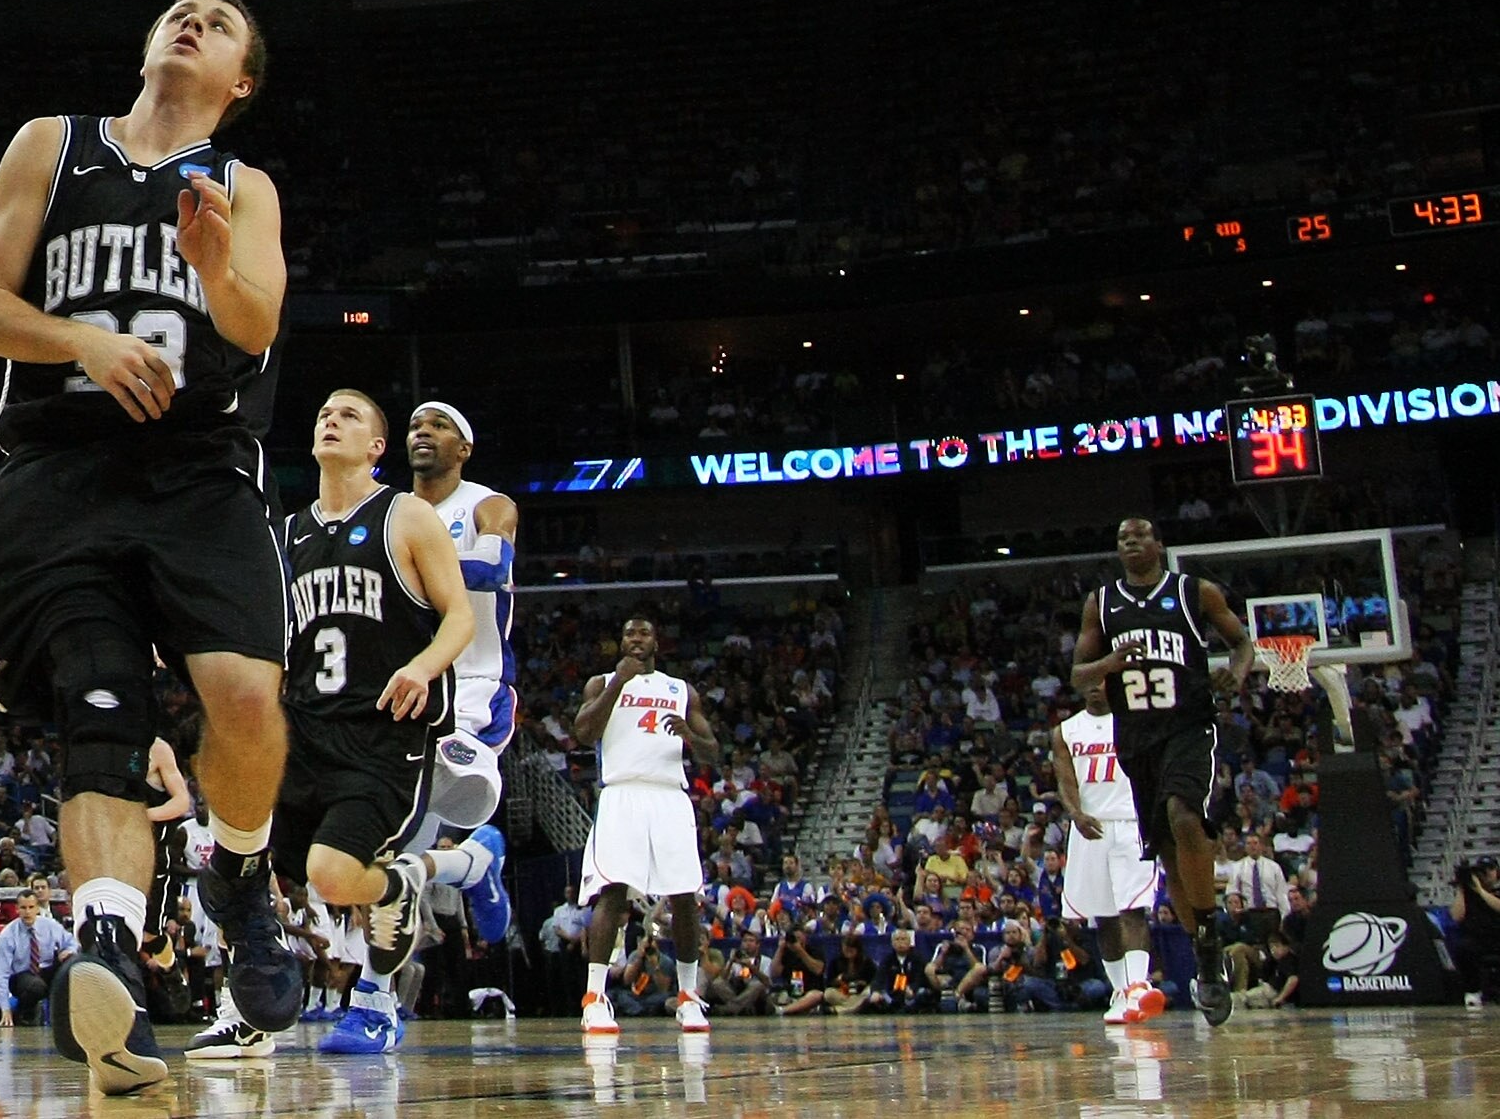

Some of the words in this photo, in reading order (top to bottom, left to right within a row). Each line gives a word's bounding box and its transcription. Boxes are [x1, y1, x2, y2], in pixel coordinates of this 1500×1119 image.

[1413, 192, 1483, 225] 4:33
[1297, 214, 1332, 242] 25
[1253, 404, 1307, 433] 4:33
[690, 442, 901, 484] WELCOME
[910, 435, 969, 468] TO
[978, 426, 1063, 465] THE
[1073, 415, 1160, 453] 2011
[1250, 431, 1308, 476] 34
[314, 626, 348, 695] 3
[619, 693, 678, 712] FLORIDA
[1121, 667, 1177, 712] 23
[637, 710, 658, 734] 4
[1085, 755, 1117, 784] 11
[1342, 975, 1413, 992] BASKETBALL
